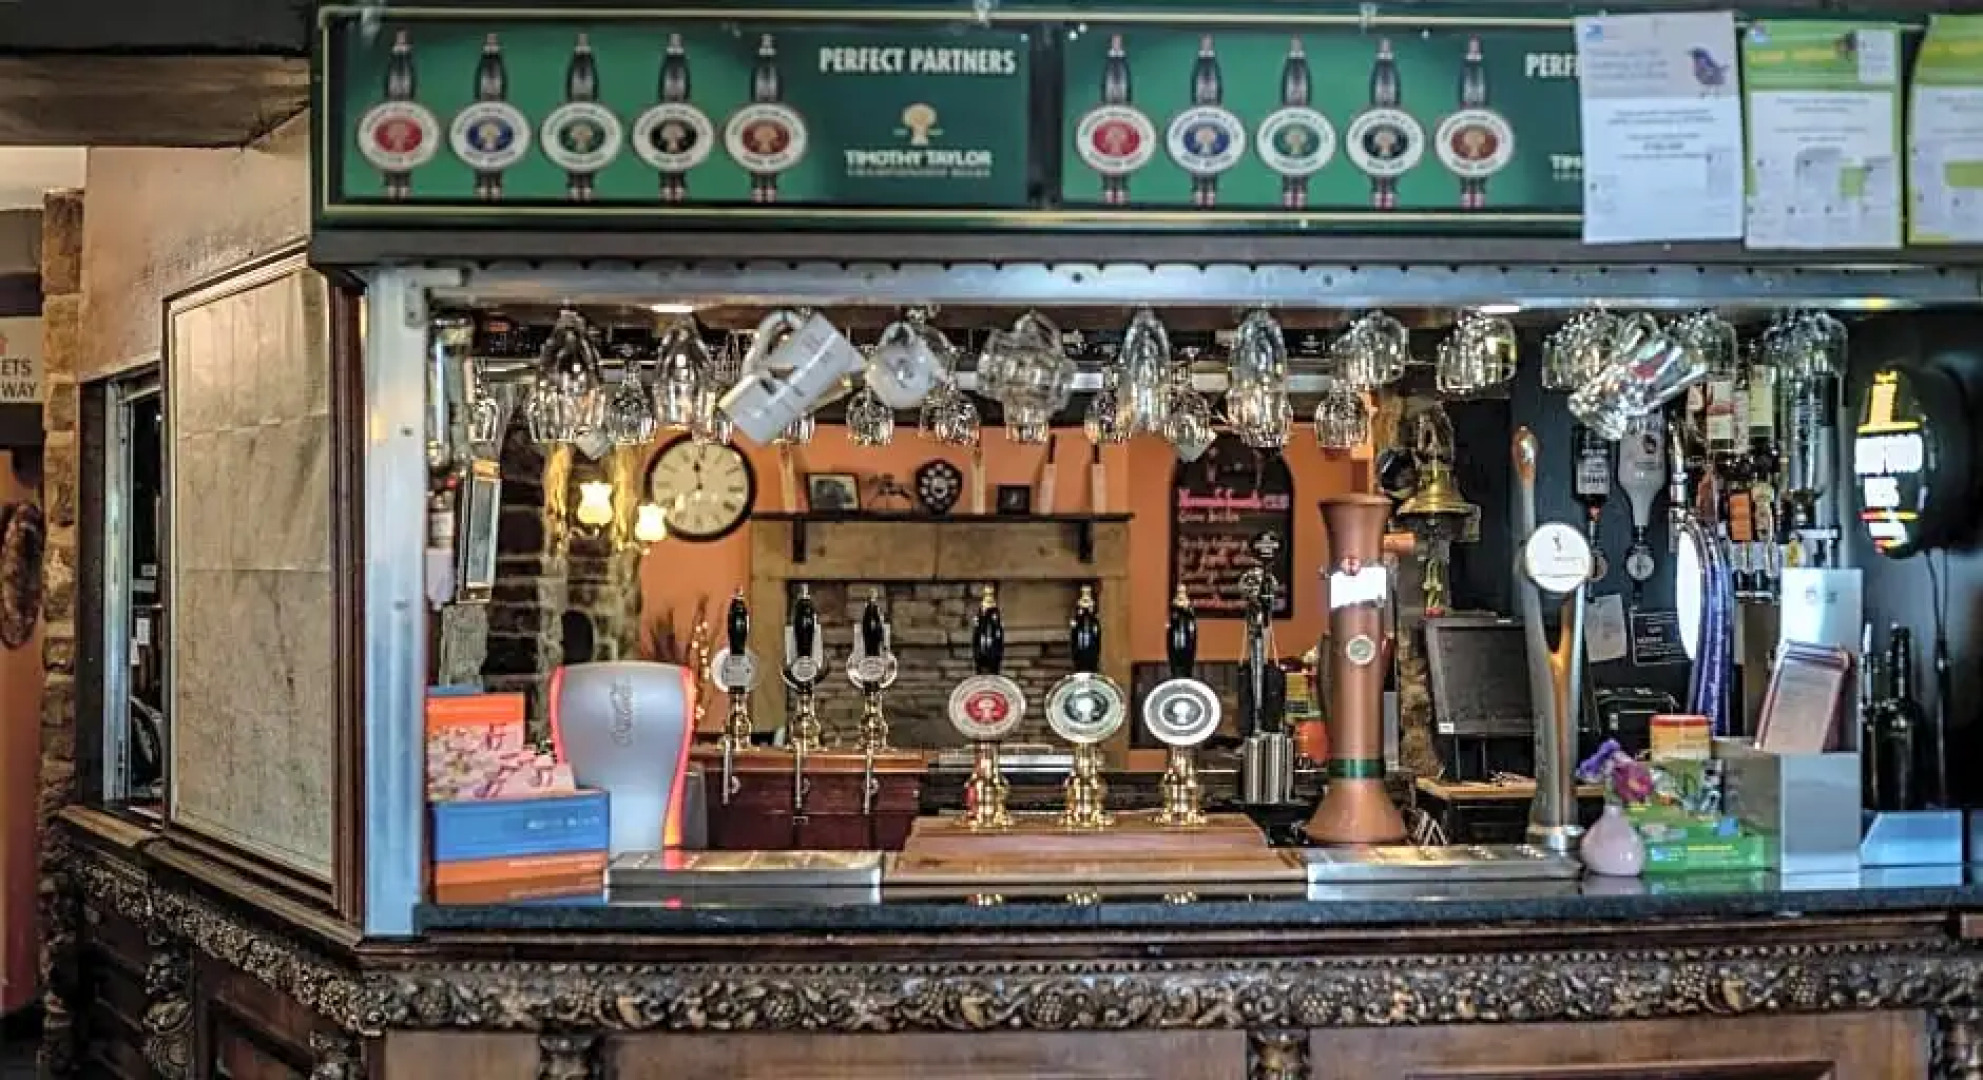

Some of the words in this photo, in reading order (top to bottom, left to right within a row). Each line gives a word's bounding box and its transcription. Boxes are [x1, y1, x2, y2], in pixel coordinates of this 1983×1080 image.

[820, 47, 905, 73] PERFECT
[910, 48, 1016, 75] PARTNERS
[845, 149, 921, 167] TIMOTHY
[926, 150, 992, 167] TAYLOR
[2, 358, 32, 377] ETS
[1, 381, 37, 398] WAY
